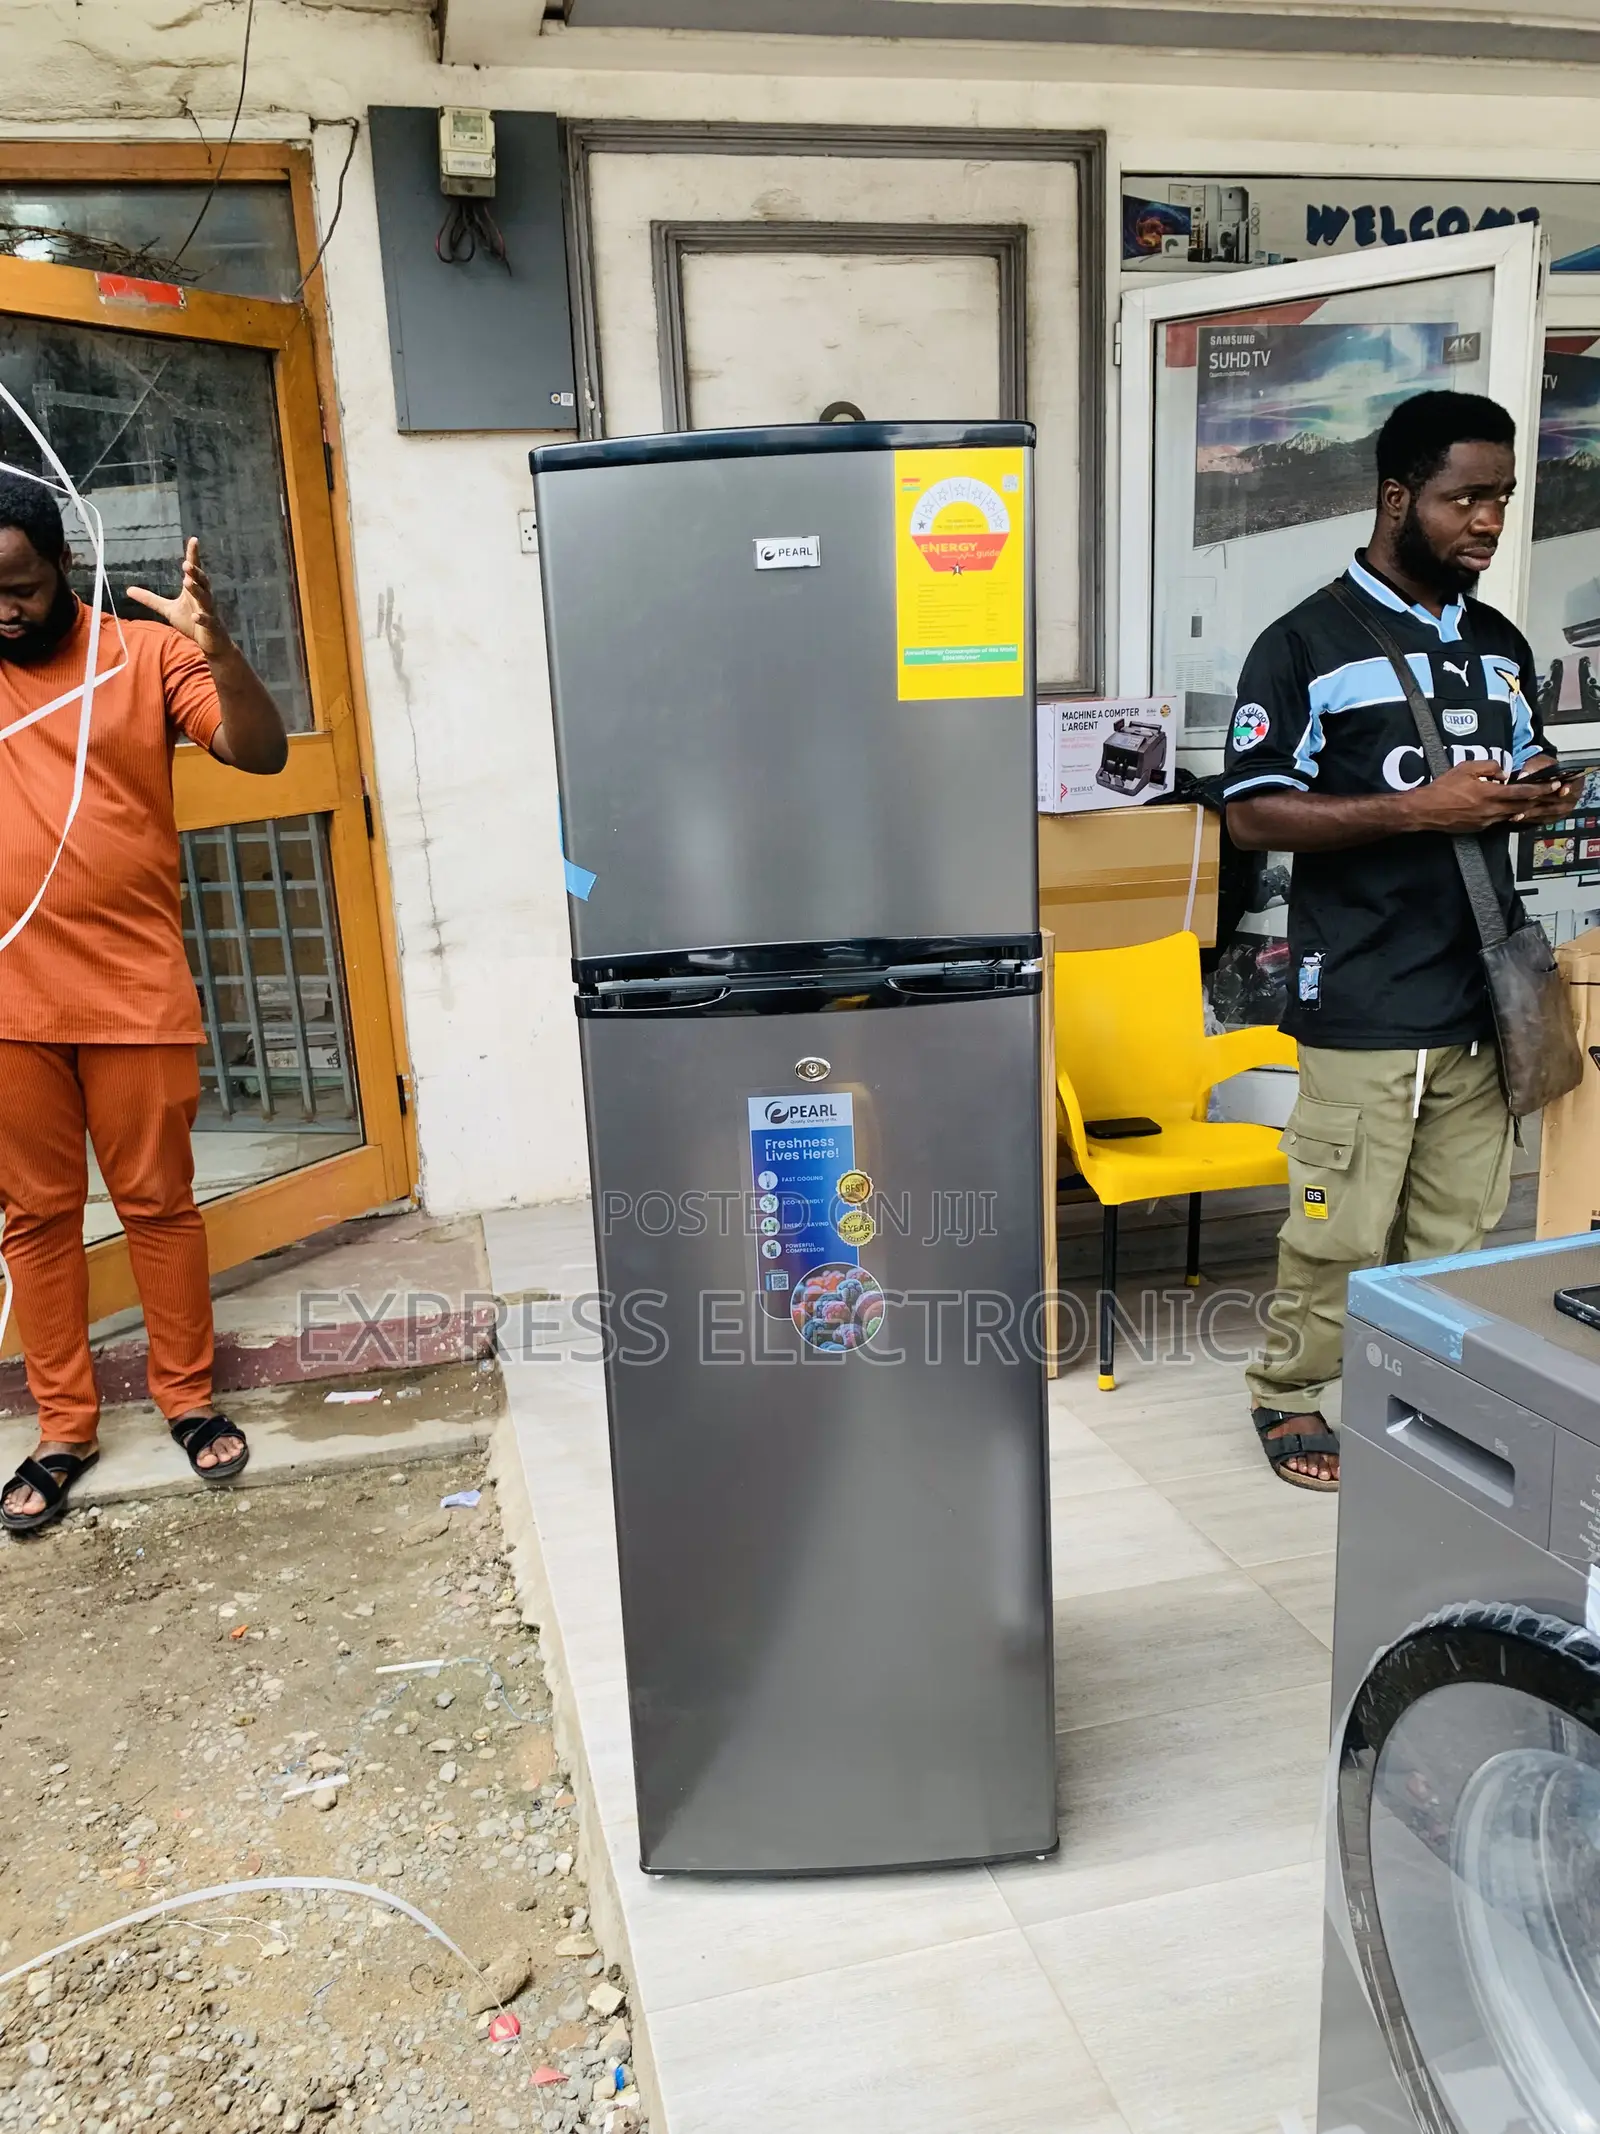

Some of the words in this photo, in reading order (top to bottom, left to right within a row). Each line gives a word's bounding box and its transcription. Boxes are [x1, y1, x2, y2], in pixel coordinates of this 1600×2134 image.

[1209, 334, 1256, 345] SAMSUNG
[1448, 336, 1474, 352] 4K
[778, 546, 813, 557] PEARL
[920, 541, 978, 555] ENERGY
[1061, 710, 1097, 720] MACHINE
[1097, 710, 1103, 718] A
[1104, 707, 1140, 718] COMPTER
[1247, 706, 1267, 723] CALCIO
[1444, 714, 1474, 725] CIRIO
[1061, 721, 1098, 731] L'ARGENT
[789, 1104, 838, 1119] PEARL
[765, 1137, 835, 1150] Freshness
[765, 1150, 800, 1162] Lives
[803, 1148, 840, 1160] Here!
[845, 1183, 866, 1194] BEST
[1307, 1190, 1322, 1201] GS
[847, 1224, 871, 1232] YEAR
[1384, 1353, 1402, 1377] LG
